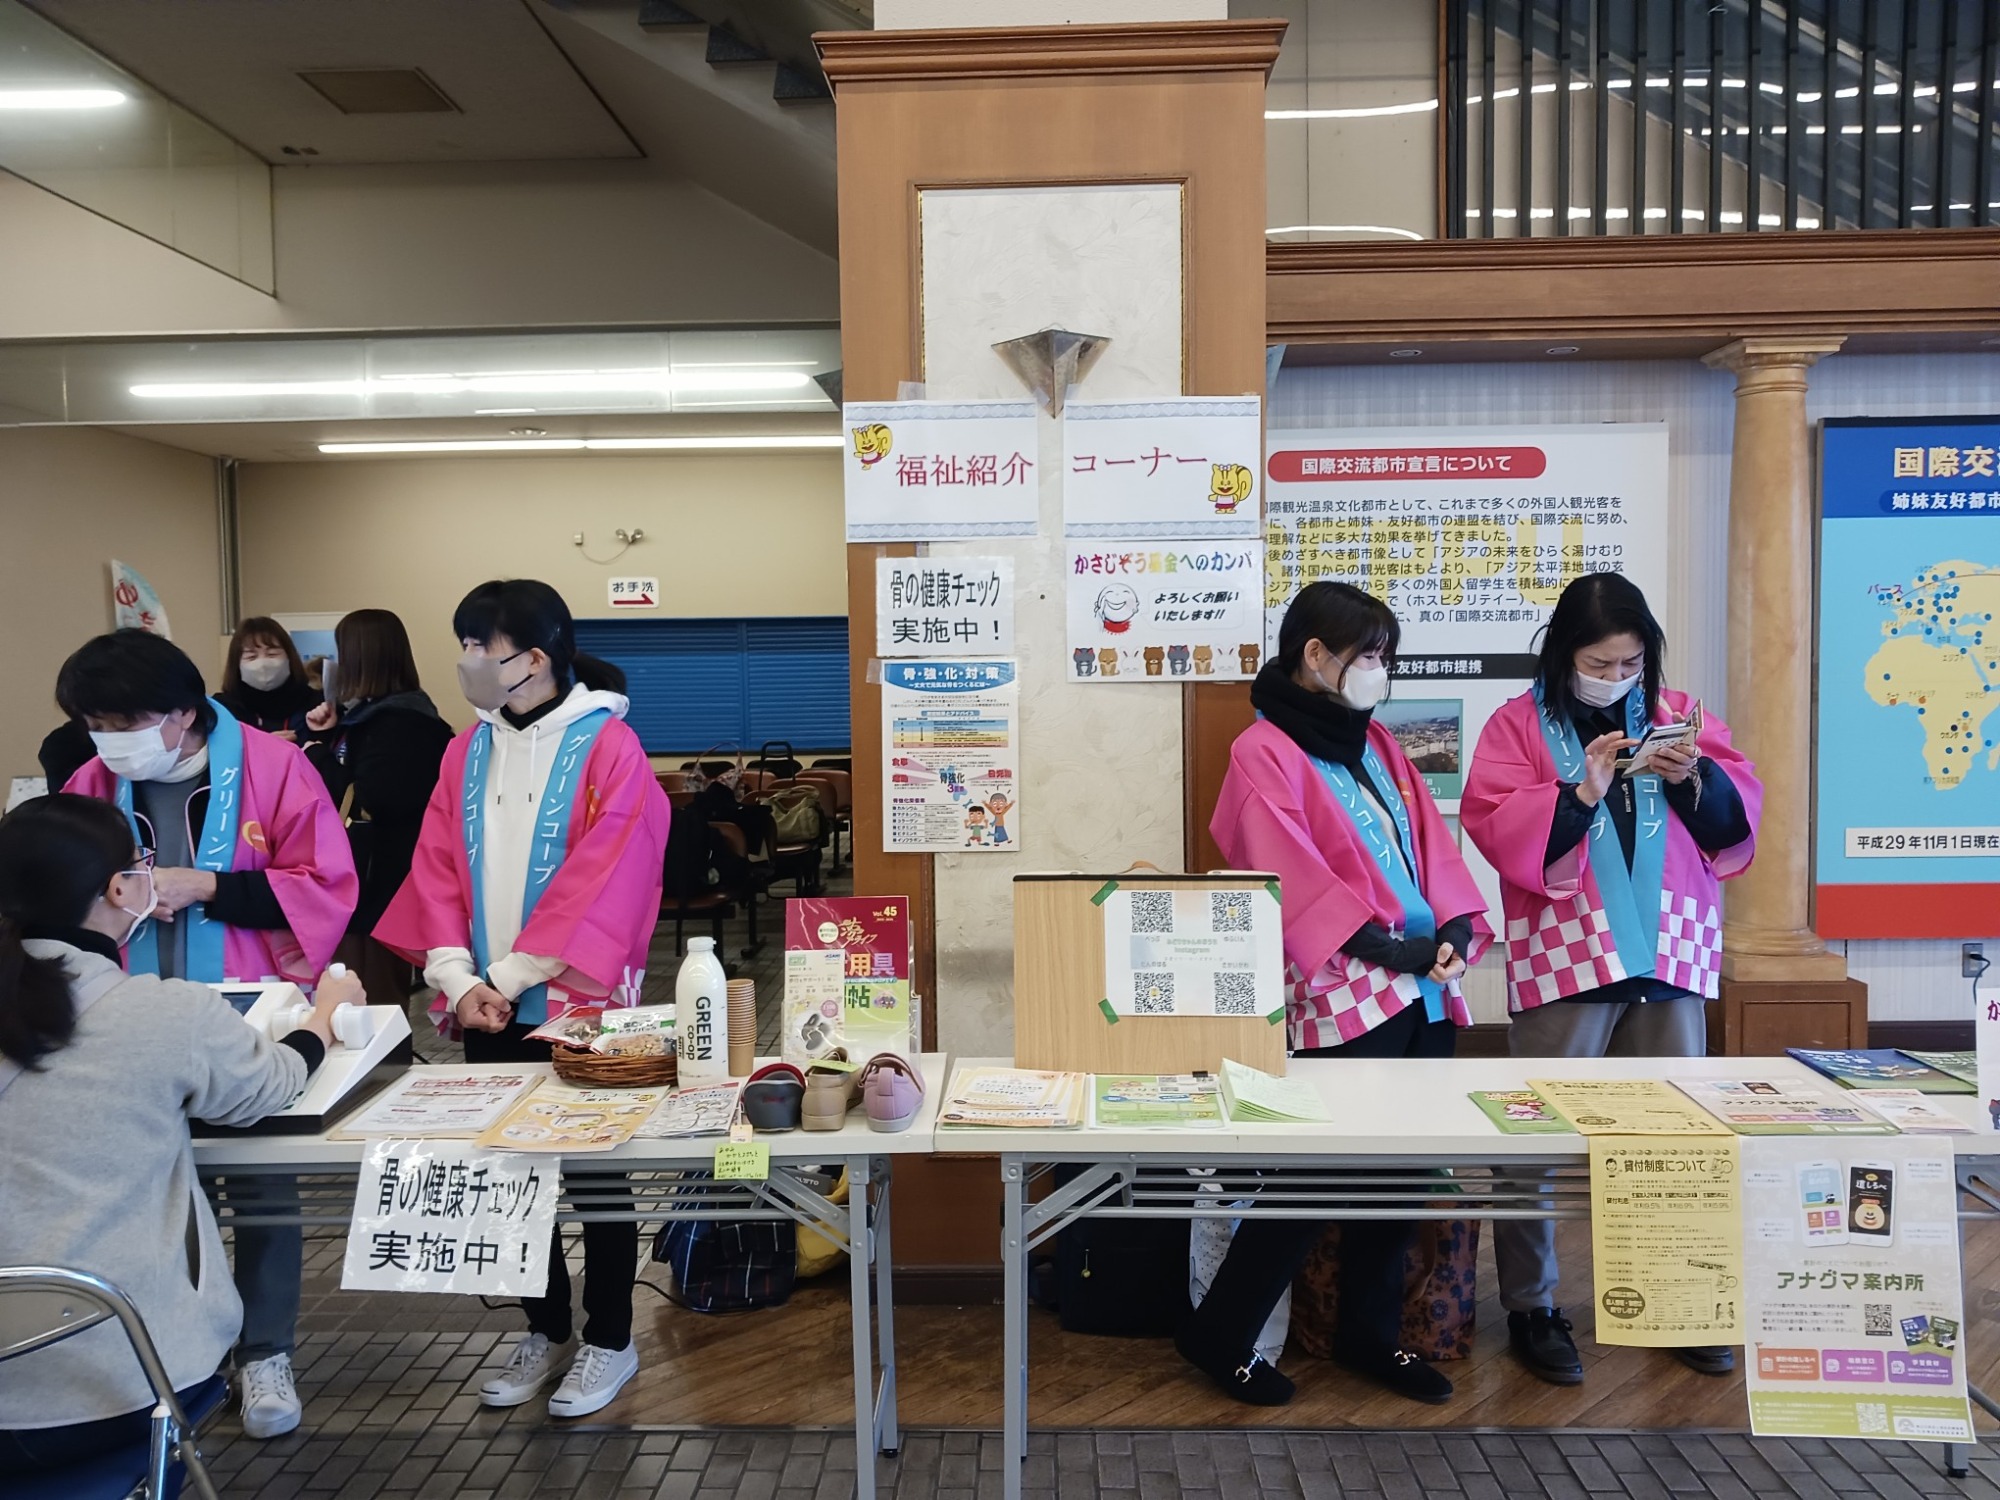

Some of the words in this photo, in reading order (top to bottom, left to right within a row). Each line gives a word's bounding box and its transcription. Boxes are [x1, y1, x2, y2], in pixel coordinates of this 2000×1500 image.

[895, 451, 1035, 488] 福祉紹介
[1072, 446, 1208, 478] コーナー
[1301, 454, 1512, 475] 国際交流都市宣言について
[1893, 446, 2000, 478] 国際交
[1265, 497, 1623, 514] 際観光温泉文化都市として、これまで多くの外国人観光客を
[1265, 513, 1628, 529] に、各都市と姉妹・友好都市の連盟を結び、国際交流に努め、
[1265, 530, 1513, 546] 理解などに多大な効果を挙げてきました。
[1075, 550, 1252, 575] かさじぞう基金へのカンパ
[1265, 545, 1623, 561] 後めざすべき都市像として「アジアの未来をひらく湯けむり
[1265, 561, 1624, 577] 、諸外国からの観光客はもとより、「アジア太平洋地域の玄
[612, 582, 654, 593] お手洗
[890, 569, 1002, 609] 骨の健康チェック
[1154, 591, 1239, 604] よろしくお願い
[1867, 584, 1903, 594] バース
[891, 616, 1000, 645] 実施中！
[903, 666, 1000, 681] 骨・強・化・対・策
[534, 733, 592, 885] グリーンコープ
[883, 906, 898, 917] 45
[845, 952, 895, 977] 用具
[844, 985, 871, 1009] 帖
[696, 996, 712, 1060] GREEN
[1624, 1159, 1706, 1173] 貸付制度について
[377, 1157, 540, 1220] 骨の健康チェック
[369, 1230, 528, 1275] 実施中！
[1777, 1269, 1924, 1291] アナグマ案内所
